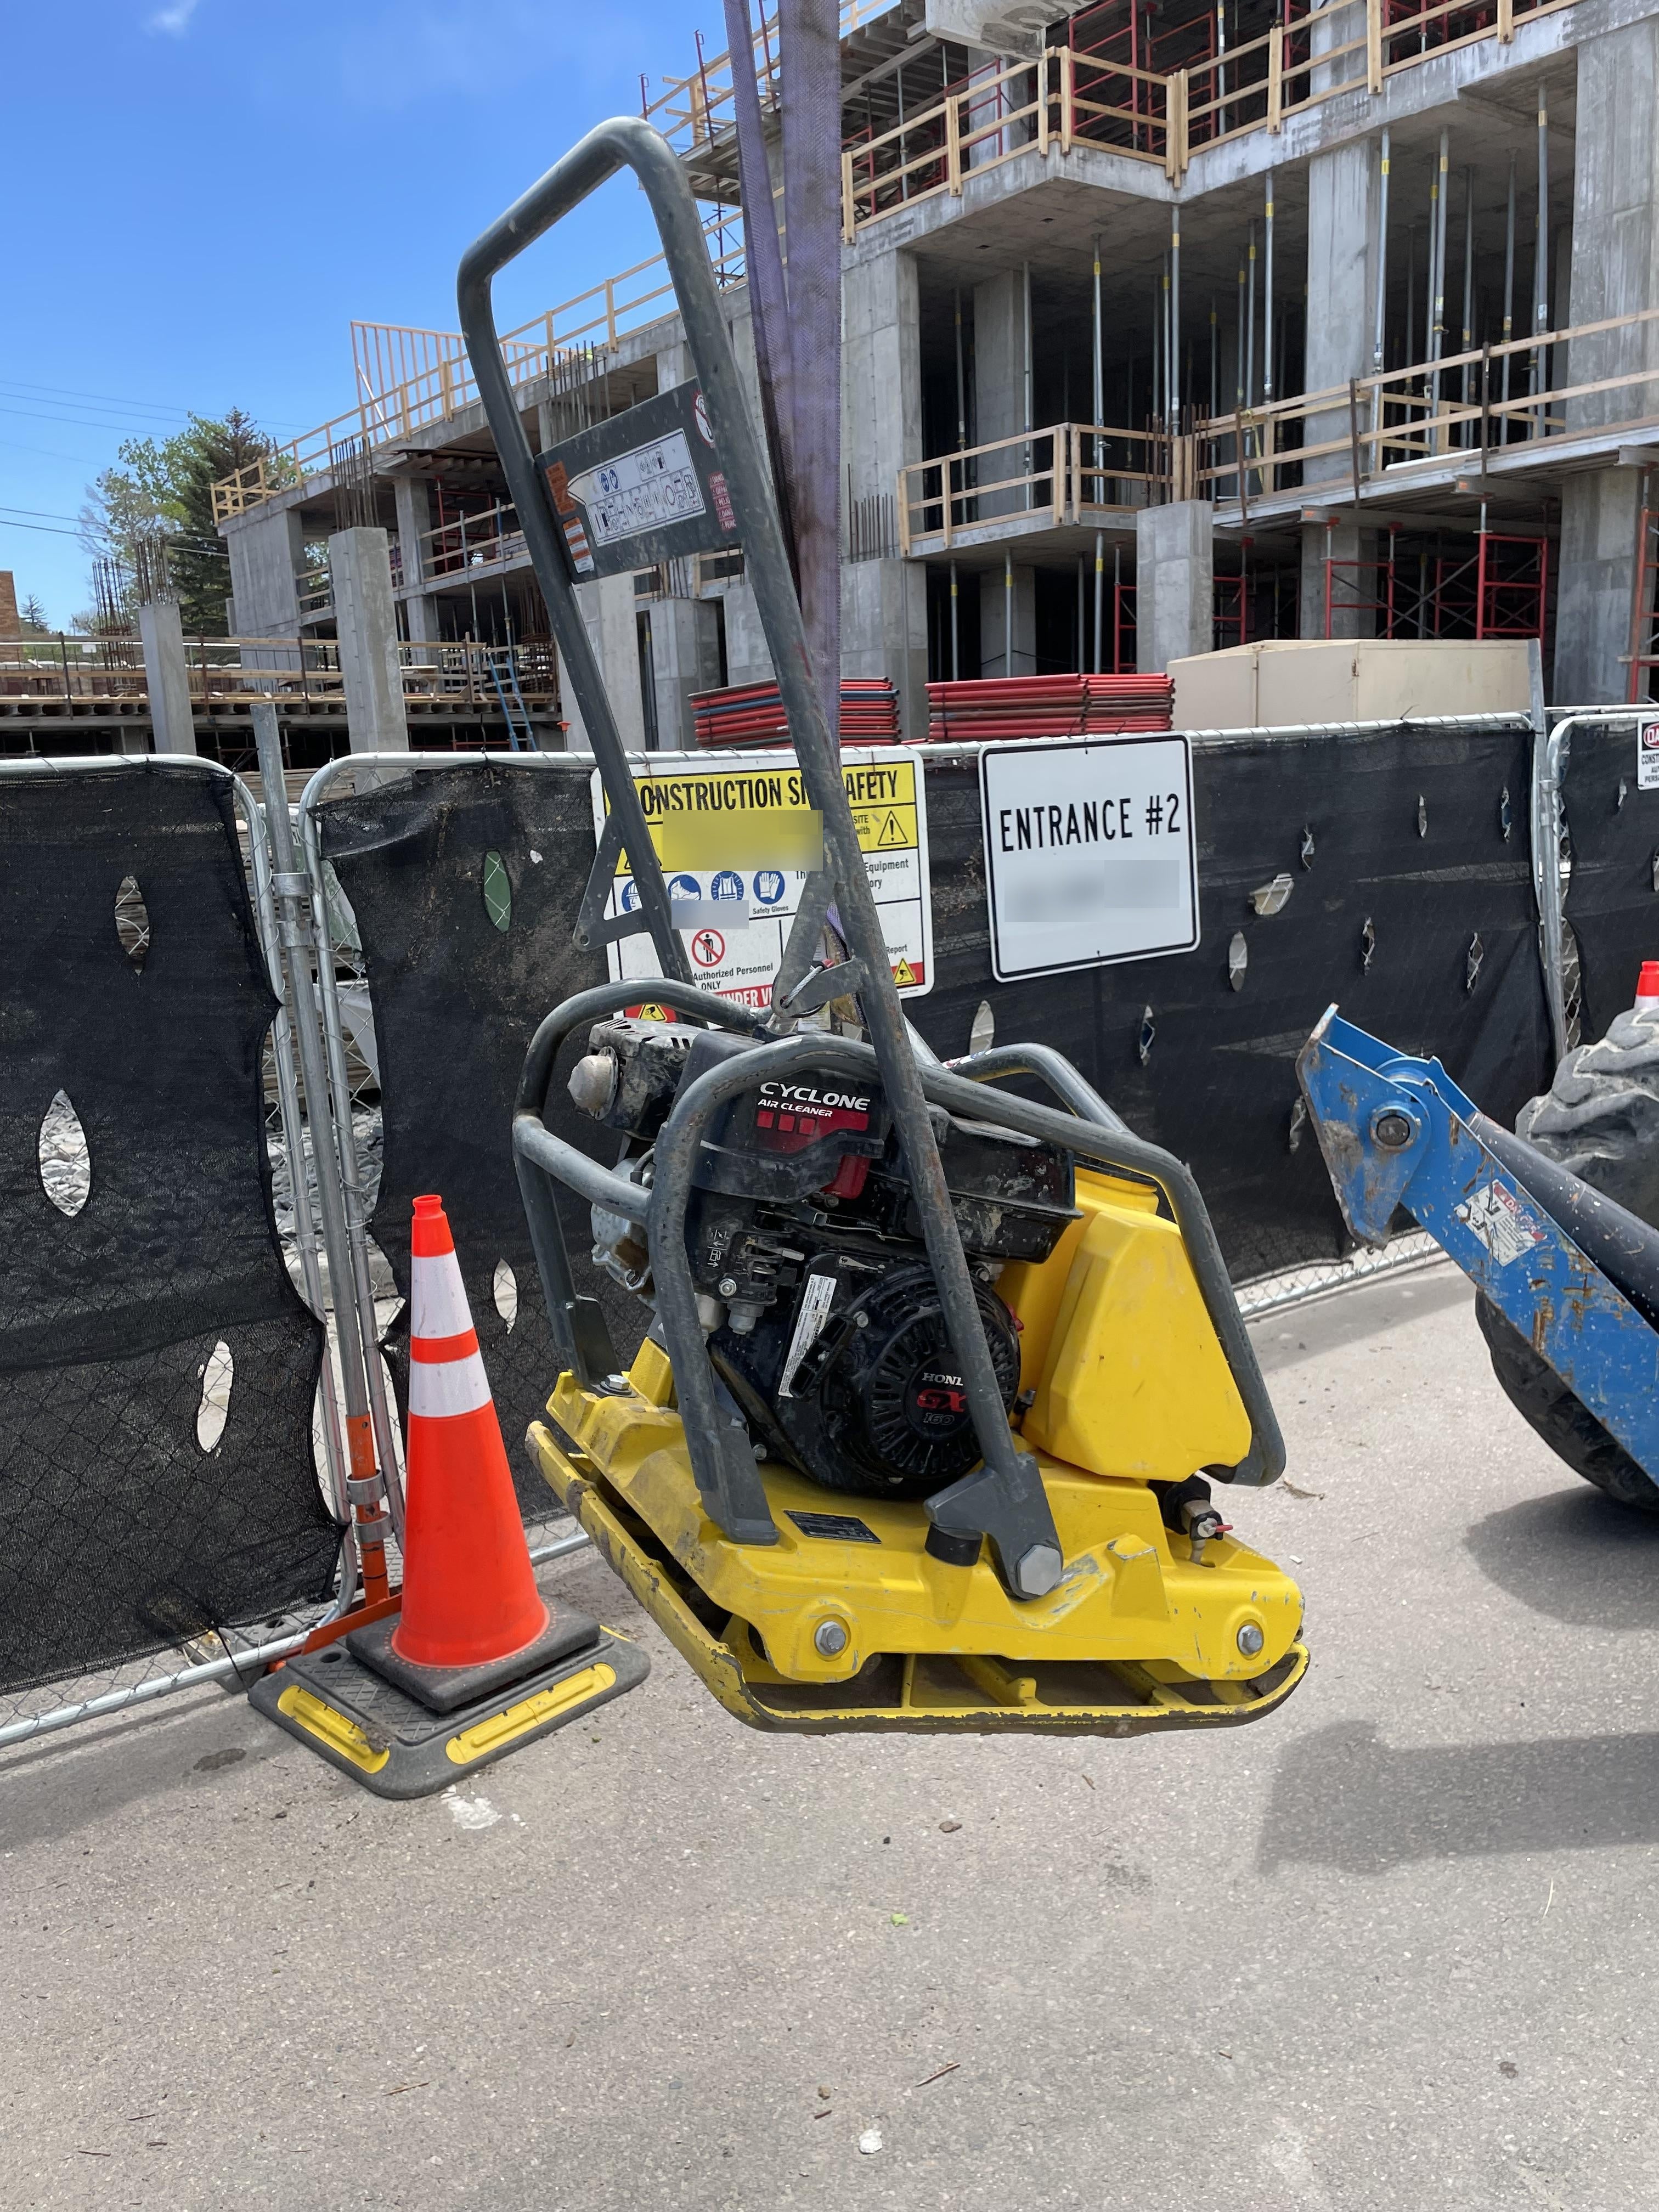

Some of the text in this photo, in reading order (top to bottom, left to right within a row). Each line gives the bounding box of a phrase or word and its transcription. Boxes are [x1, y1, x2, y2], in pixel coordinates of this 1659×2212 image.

[640, 770, 898, 816] ONSTRUCTION SI AFETY
[1000, 793, 1181, 853] ENTRANCE #2
[865, 859, 909, 873] Equipment
[870, 879, 882, 889] ory
[886, 944, 908, 955] Report
[694, 962, 774, 981] Authorized Personnel
[701, 980, 721, 991] ONLY
[719, 989, 758, 1007] NDER
[760, 1081, 871, 1111] CYCLONE
[758, 1098, 833, 1118] AIR CLEANER
[917, 1389, 968, 1413] GX
[923, 1412, 955, 1426] 160
